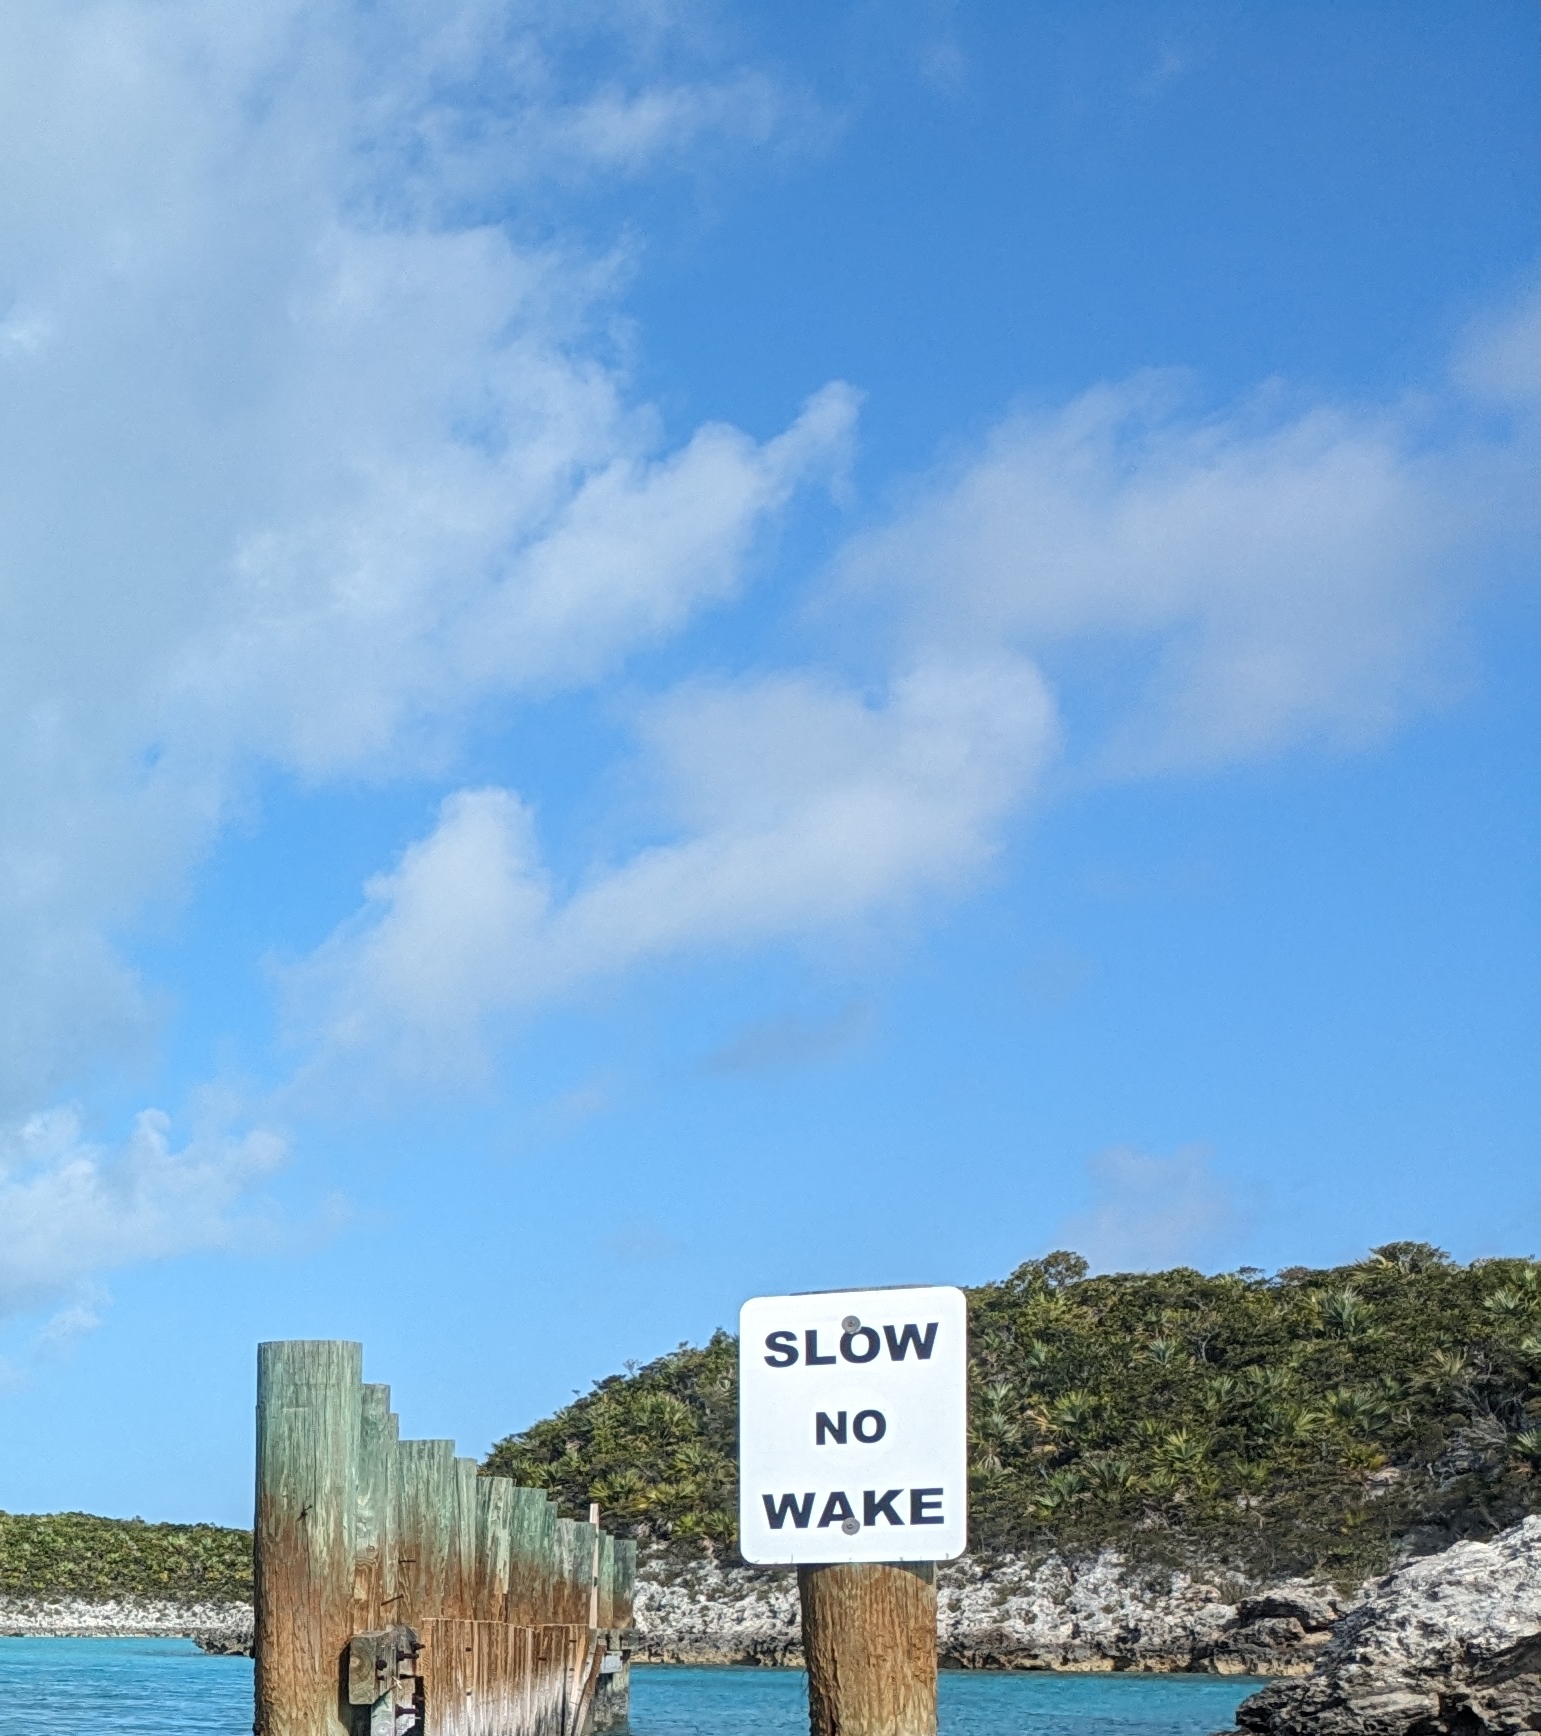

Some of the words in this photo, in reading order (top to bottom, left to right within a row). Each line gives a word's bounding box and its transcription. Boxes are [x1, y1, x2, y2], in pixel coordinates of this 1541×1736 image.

[764, 1322, 939, 1368] SLOW
[816, 1409, 887, 1446] NO
[762, 1487, 945, 1530] WAKE
